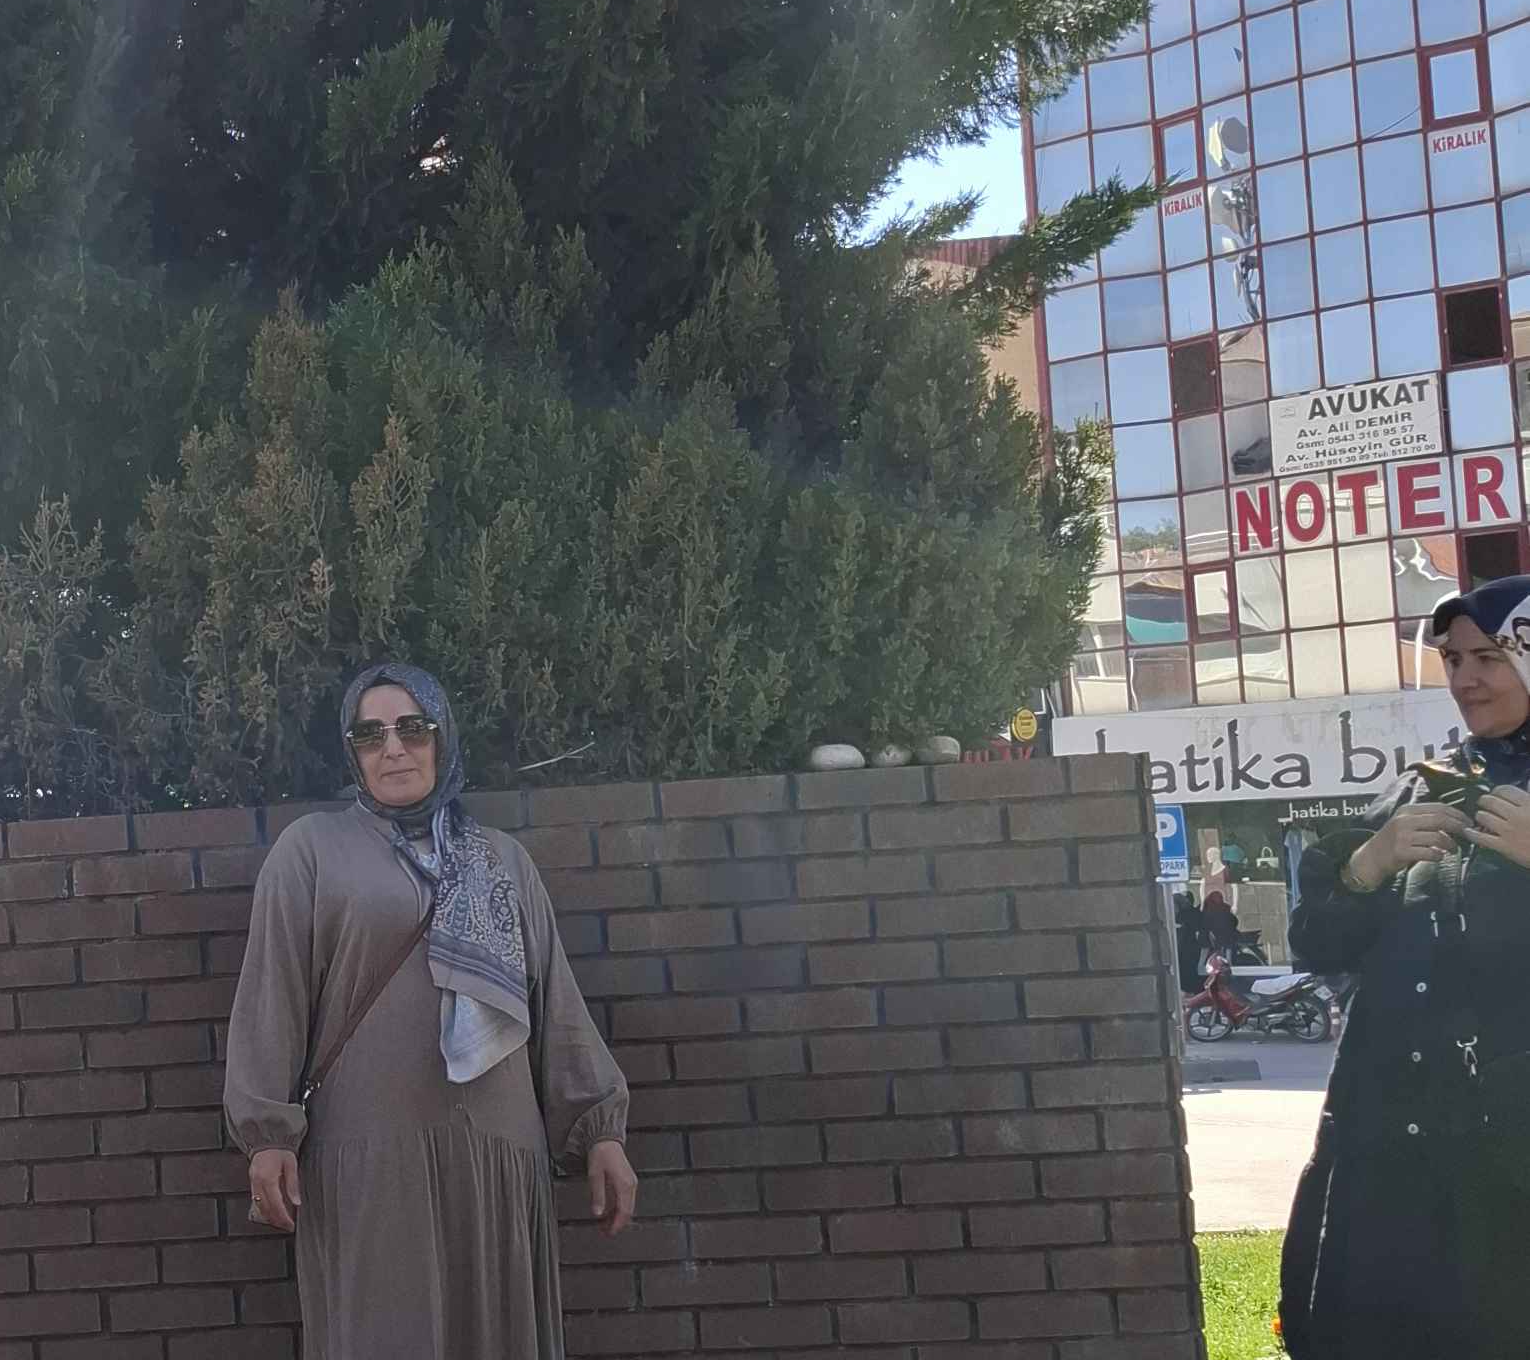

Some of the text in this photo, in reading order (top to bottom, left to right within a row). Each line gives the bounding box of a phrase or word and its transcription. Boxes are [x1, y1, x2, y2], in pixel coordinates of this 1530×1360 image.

[1432, 129, 1487, 154] KİRALIK
[1163, 191, 1203, 217] KİRALIK
[1308, 378, 1430, 421] AVUKAT
[1297, 411, 1413, 439] Av. Ali DEMİR
[1285, 453, 1309, 464] Av.
[1315, 441, 1383, 459] Hüseyin
[1235, 455, 1511, 552] NOTER
[1288, 800, 1339, 820] hatika
[1155, 812, 1177, 852] P
